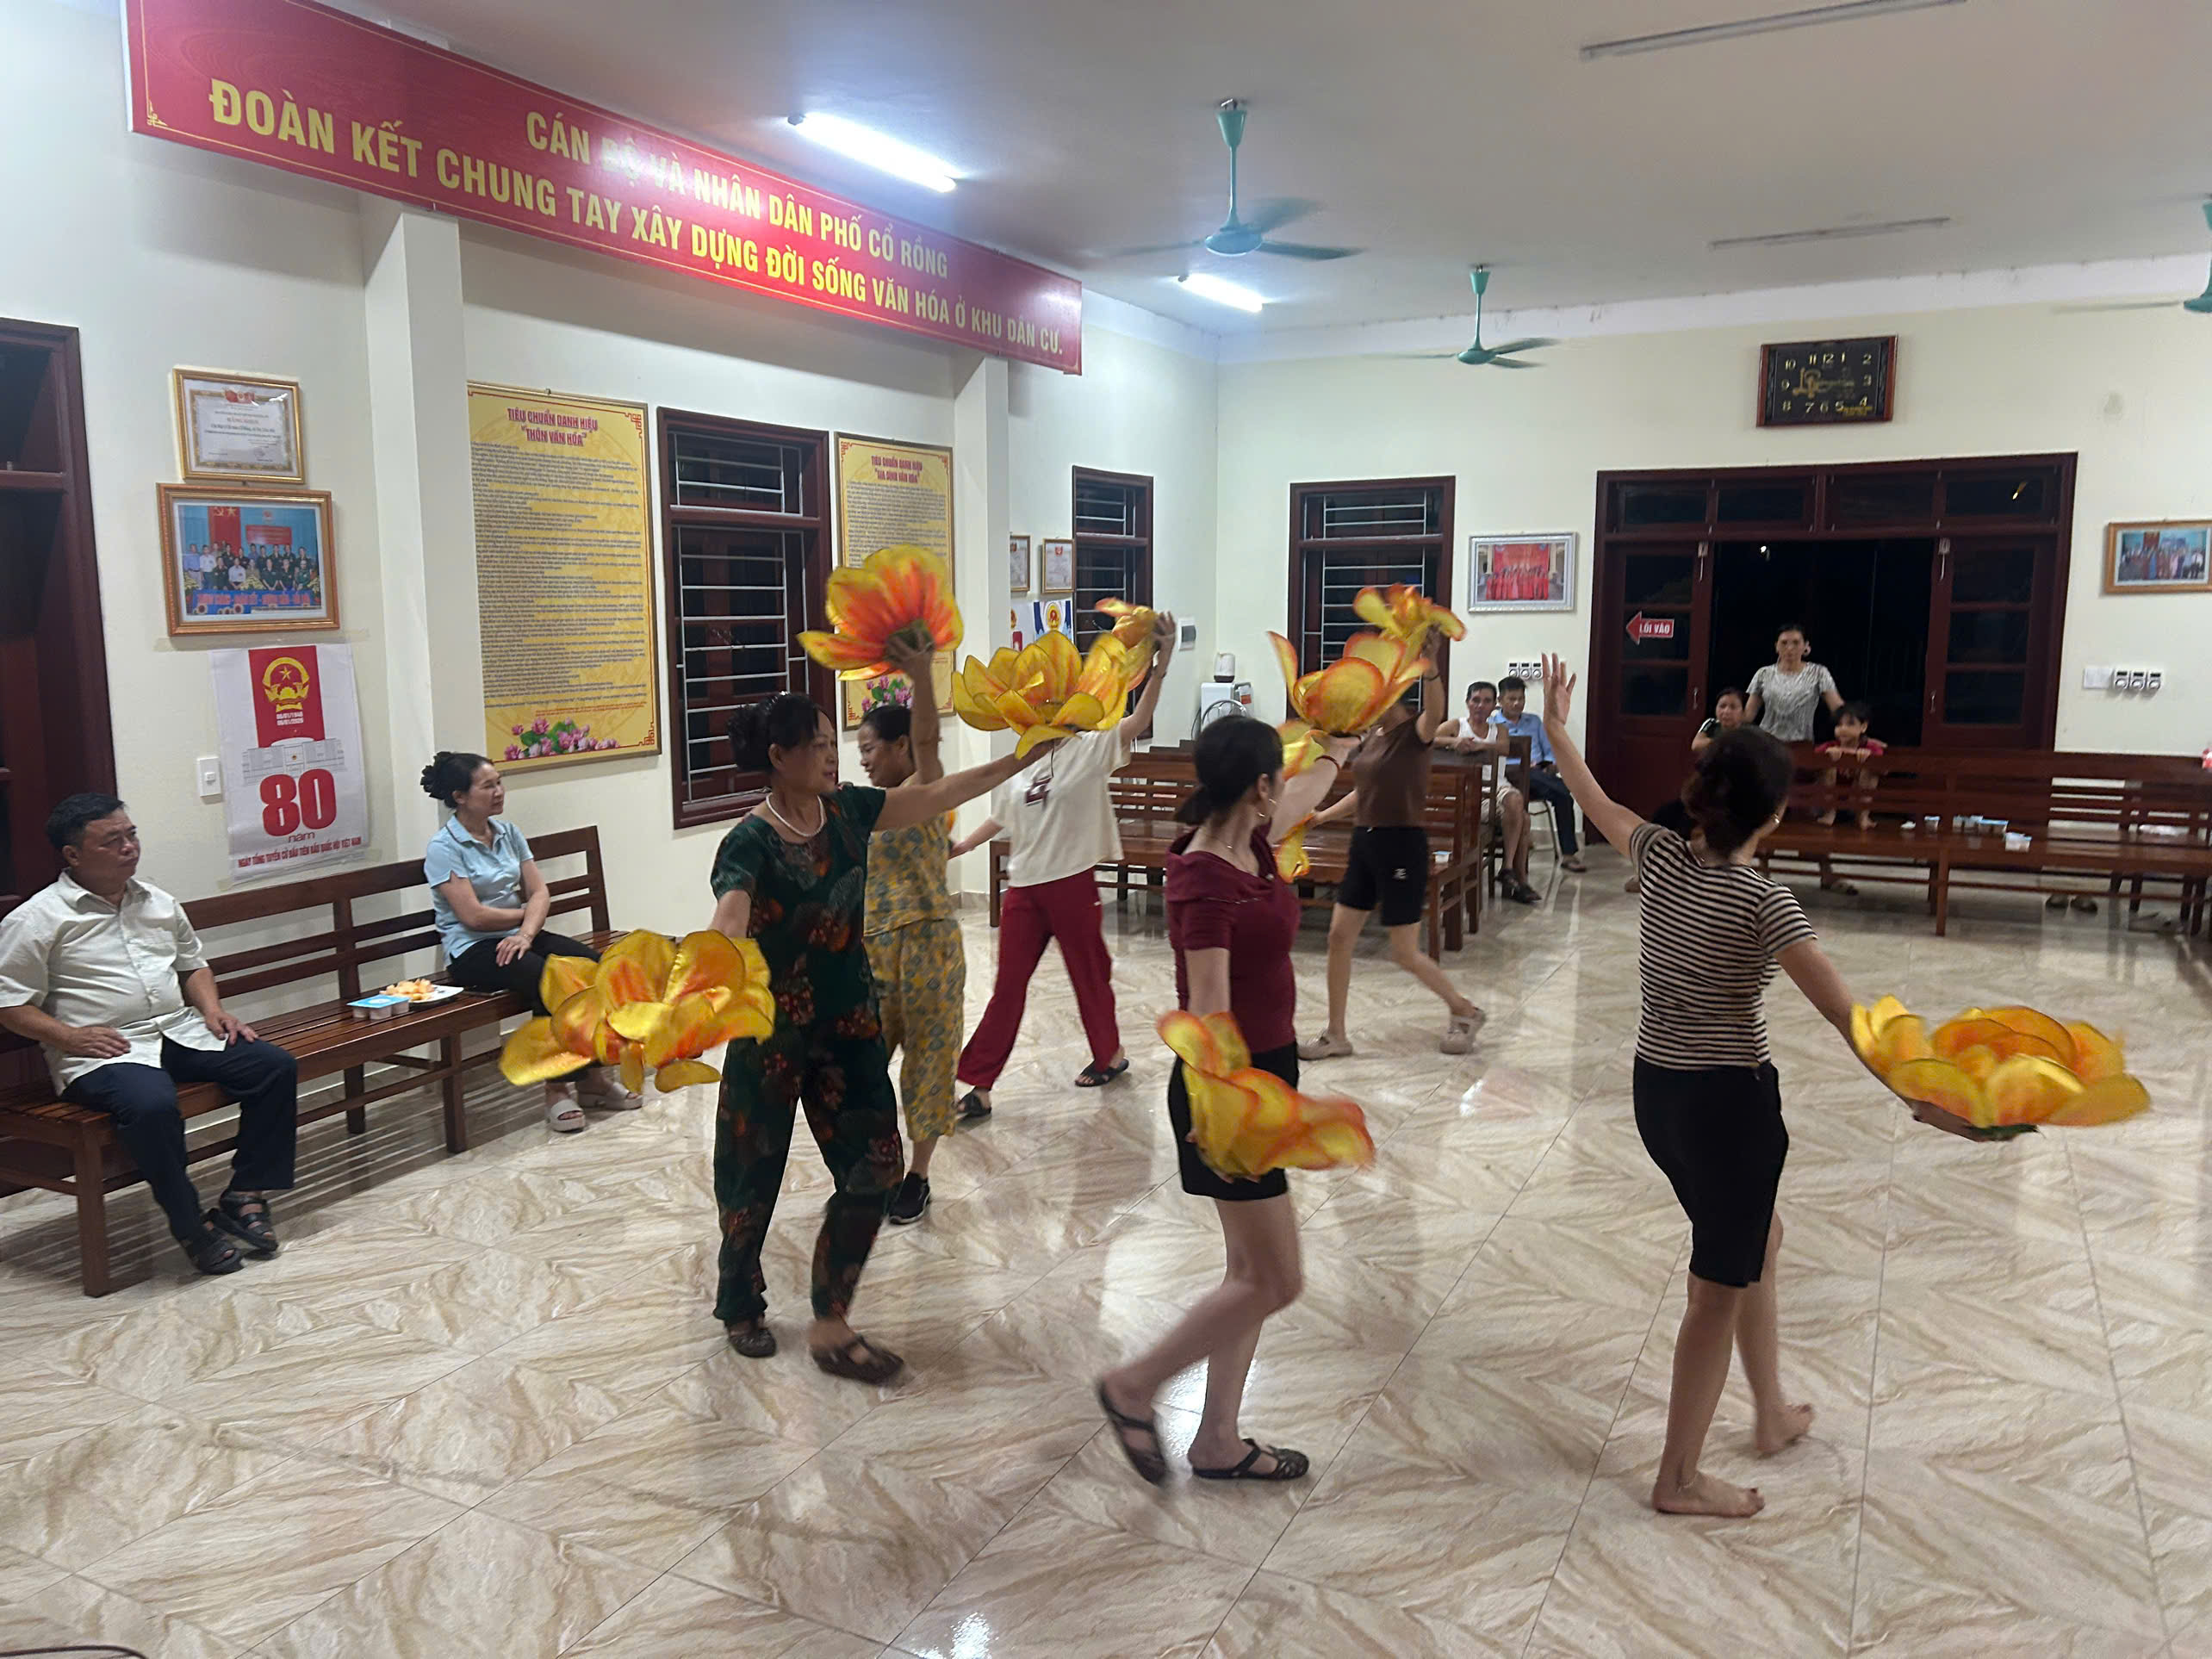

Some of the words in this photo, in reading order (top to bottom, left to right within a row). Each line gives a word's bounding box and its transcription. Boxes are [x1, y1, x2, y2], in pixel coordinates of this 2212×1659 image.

[526, 111, 590, 165] CÁN
[650, 151, 686, 196] VÀ
[694, 168, 761, 220] NHÂN
[769, 184, 813, 237] DÂN
[820, 213, 861, 252] PHỐ
[868, 222, 894, 261] CỔ
[208, 78, 335, 154] ĐOÀN
[351, 119, 423, 178] KẾT
[437, 148, 556, 217] CHUNG
[566, 186, 622, 234] TAY
[631, 204, 683, 252] XÂY
[692, 224, 758, 272] DỰNG
[765, 244, 805, 286] ĐỜI
[812, 257, 866, 302] SỐNG
[872, 276, 909, 314] VĂN
[915, 289, 950, 325] HÓA
[955, 295, 966, 328] Ở
[972, 307, 1002, 339] KHU
[1007, 315, 1035, 347] DÂN
[1810, 352, 1817, 365] 11
[1823, 352, 1834, 364] 12
[1841, 351, 1845, 363] 1
[1862, 353, 1872, 365] 2
[1785, 358, 1796, 370] 10
[1781, 379, 1790, 391] 9
[1863, 374, 1872, 386] 3
[1782, 400, 1792, 412] 8
[1805, 401, 1814, 413] 7
[1820, 401, 1829, 413] 6
[1835, 401, 1844, 412] 5
[1860, 395, 1867, 407] 4
[507, 407, 526, 422] TIÊU
[556, 414, 579, 429] DANH
[260, 768, 336, 836] 80
